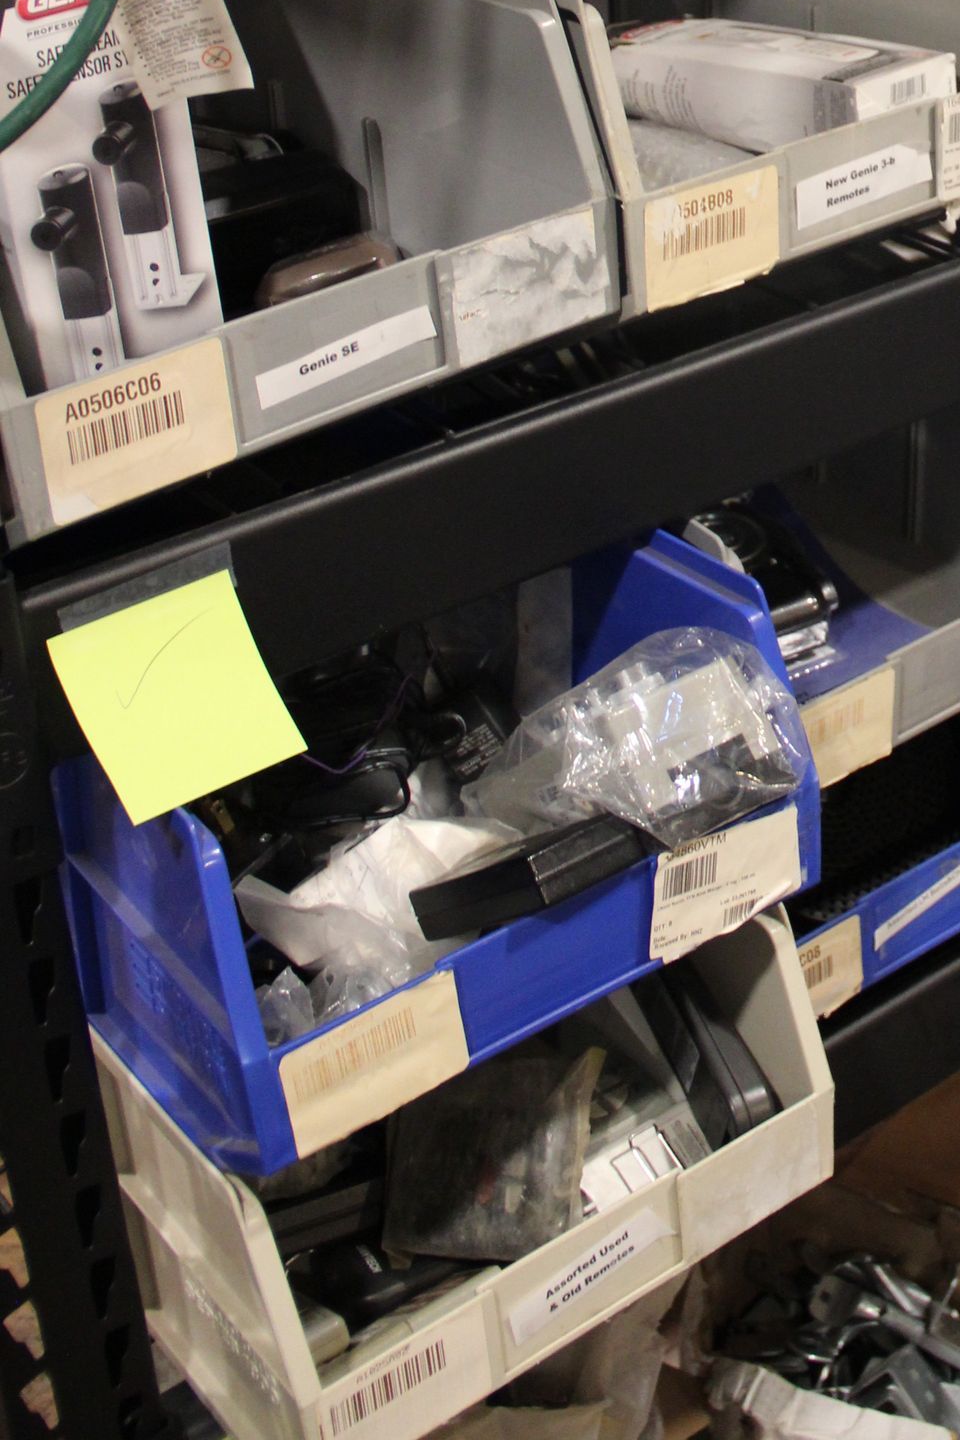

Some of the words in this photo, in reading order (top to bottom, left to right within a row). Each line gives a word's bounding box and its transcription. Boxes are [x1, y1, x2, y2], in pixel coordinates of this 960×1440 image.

[825, 176, 848, 190] New
[850, 164, 879, 180] Genie
[678, 189, 734, 219] 504B08
[826, 185, 870, 208] Remotes
[299, 350, 338, 376] Genie
[341, 340, 360, 357] SE
[65, 371, 162, 424] A0506C06
[546, 1255, 597, 1299] Assorted
[599, 1231, 629, 1257] Used
[562, 1283, 582, 1302] Old
[585, 1245, 635, 1286] Remotes
